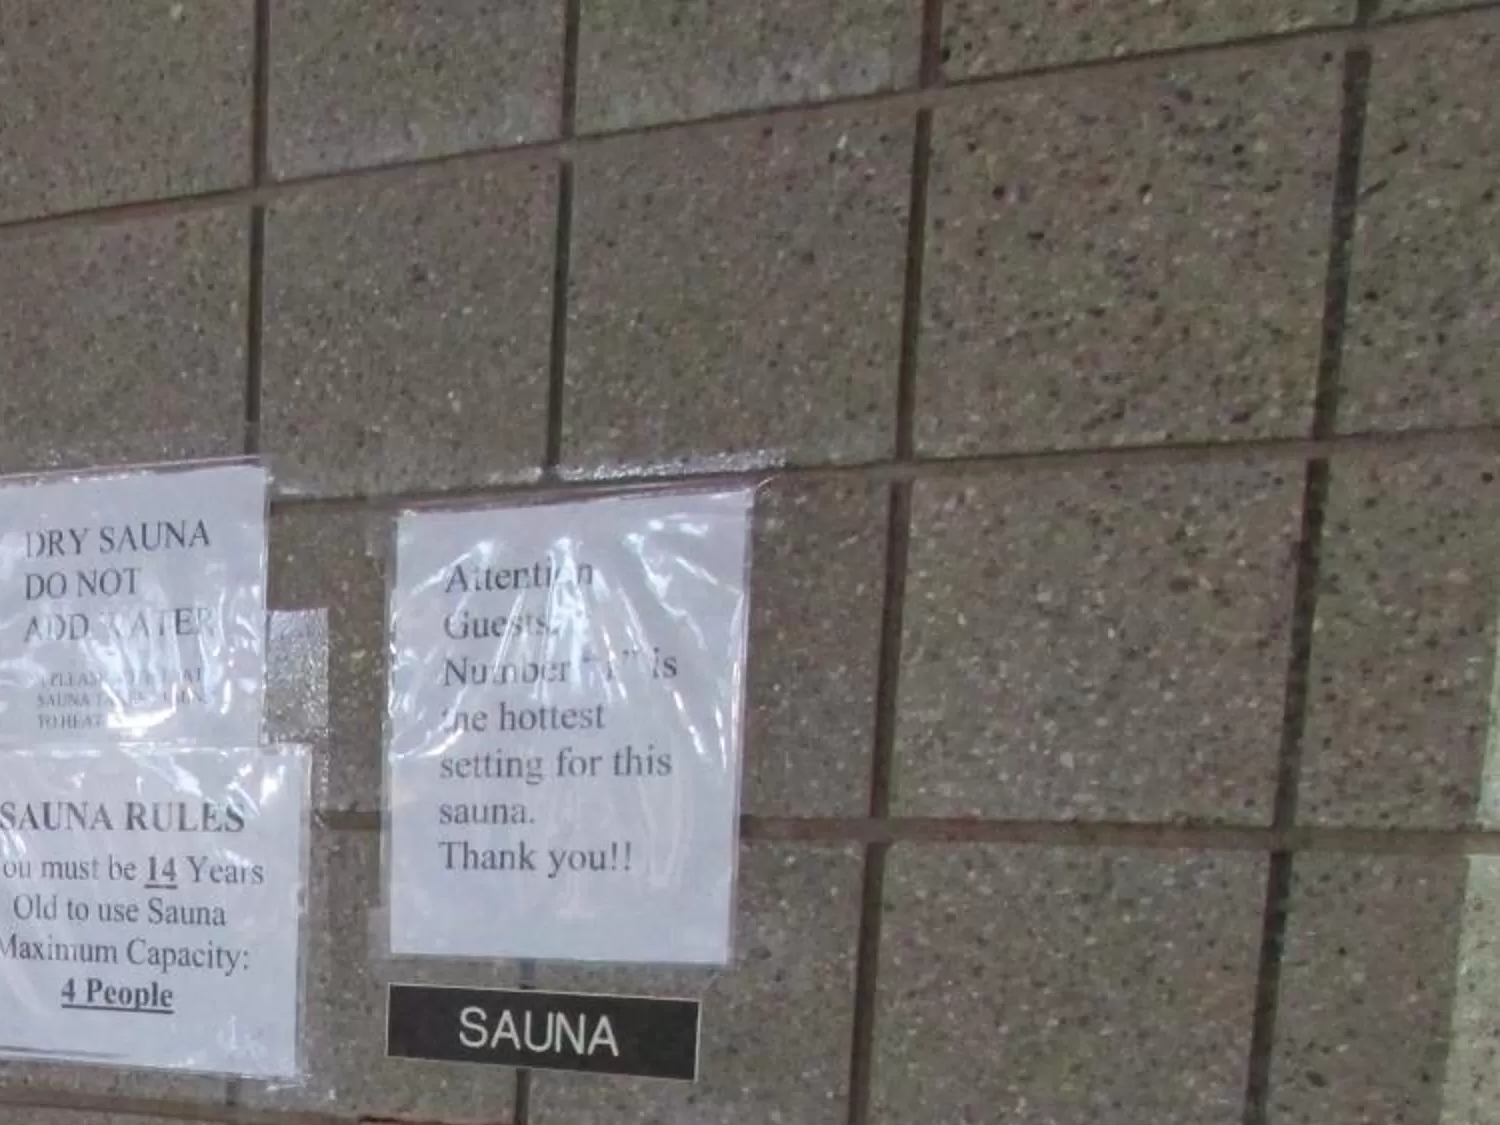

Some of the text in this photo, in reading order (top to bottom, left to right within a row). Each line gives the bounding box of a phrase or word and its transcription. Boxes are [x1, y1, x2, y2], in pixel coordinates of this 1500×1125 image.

[24, 519, 211, 560] DRY SAUNA
[24, 567, 142, 600] DO NOT
[445, 557, 594, 593] Atentin
[24, 612, 89, 643] ADD
[652, 647, 678, 679] is
[499, 701, 606, 731] hottest
[440, 745, 673, 785] setting for this
[0, 800, 246, 834] SAUNA RULES
[439, 798, 536, 827] sauna.
[41, 856, 99, 882] must
[107, 854, 137, 882] be
[146, 855, 177, 884] 14
[186, 855, 266, 885] Years
[438, 840, 633, 879] Thank you!!
[12, 893, 227, 927] Old to use Sauna
[126, 937, 250, 977] Capacity:
[61, 978, 174, 1010] 4 People
[458, 1005, 620, 1058] SAUNA
